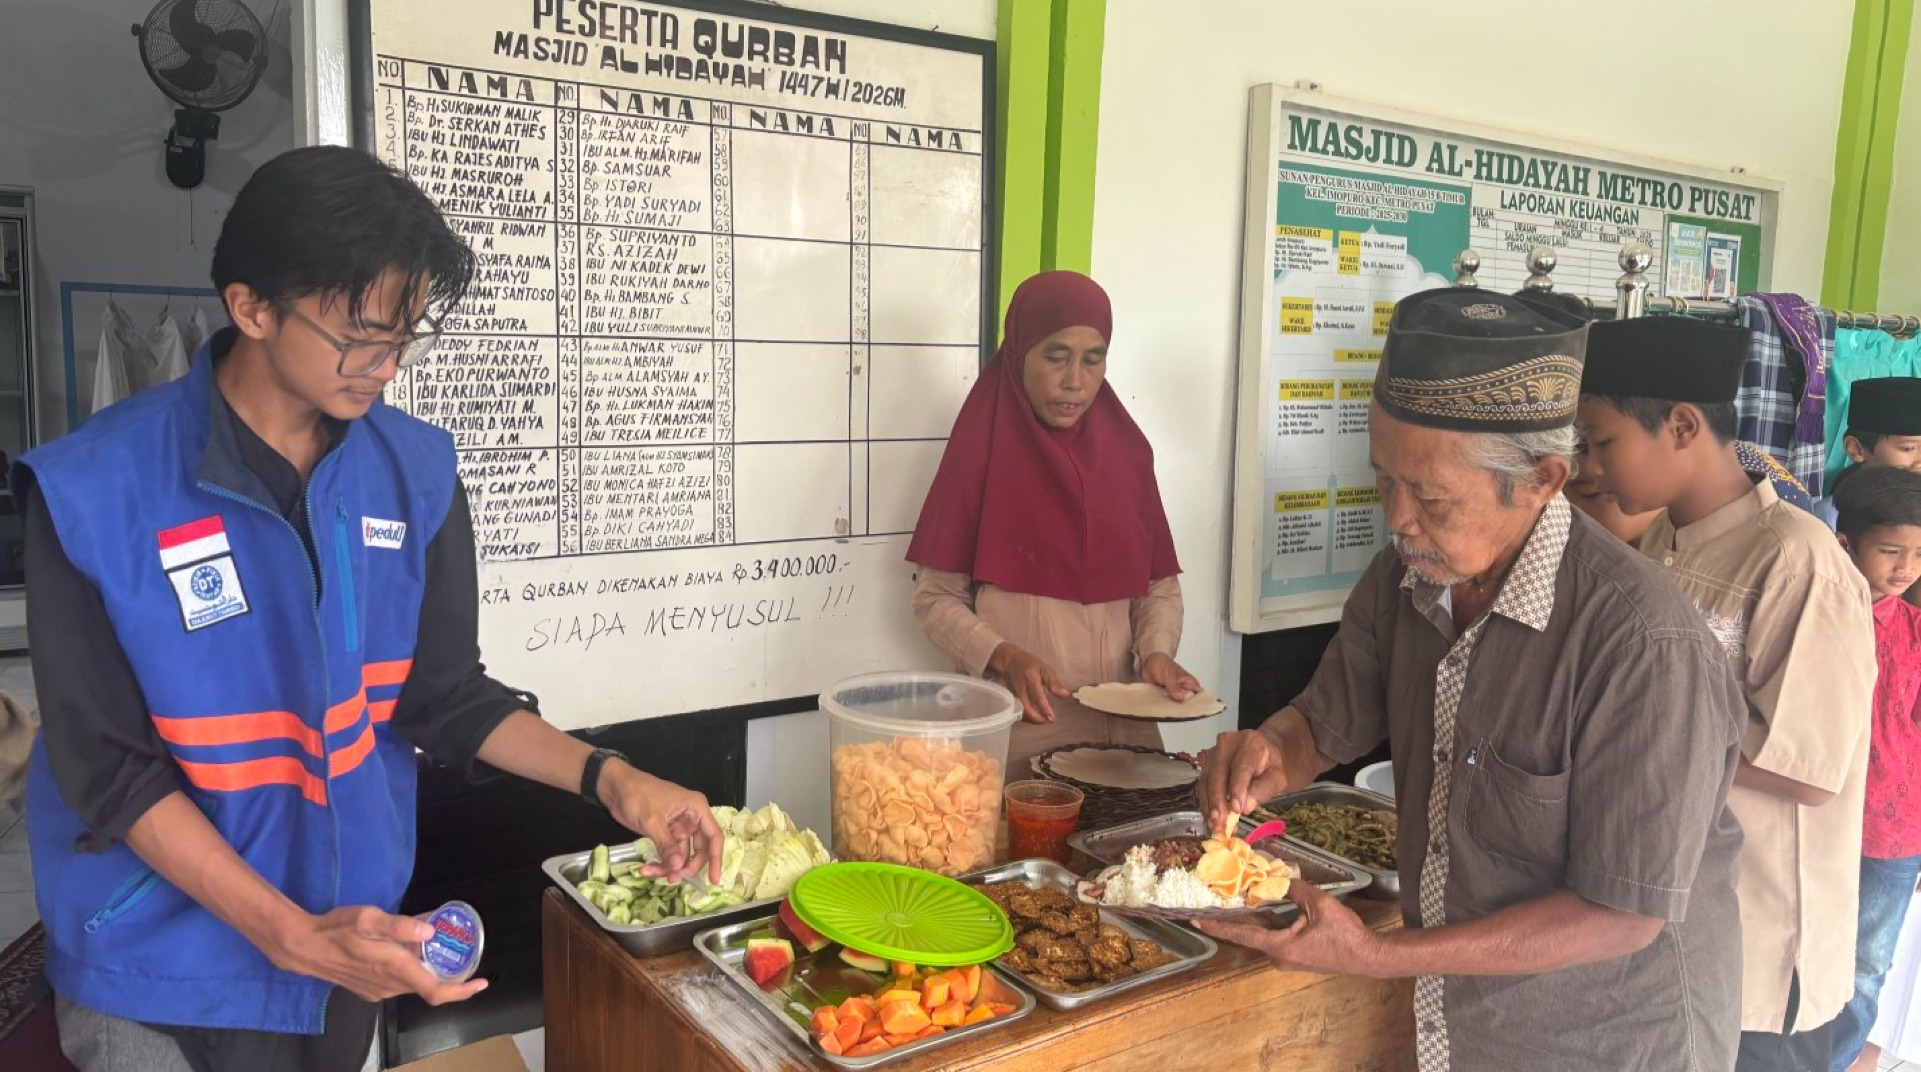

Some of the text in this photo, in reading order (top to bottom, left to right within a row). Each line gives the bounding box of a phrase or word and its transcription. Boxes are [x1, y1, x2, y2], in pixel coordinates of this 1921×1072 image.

[533, 0, 846, 74] PESERTA QURBAN
[494, 30, 588, 66] MASJID
[428, 66, 535, 101] NAMA
[601, 91, 694, 120] NAMA
[505, 106, 542, 122] MALIK
[429, 116, 547, 140] Dr. SERKAN ATHES
[750, 108, 835, 137] NAMA
[408, 129, 520, 152] IBU LINDAWATI
[640, 134, 672, 150] ARIF
[886, 125, 963, 150] NAMA
[560, 143, 574, 156] 31
[583, 145, 602, 157] IBU
[431, 149, 540, 171] KA RAJES ADITYA
[560, 159, 575, 173] 32
[1287, 114, 1755, 220] MASJID AL-HIDAYAH METRO PUSAT
[603, 161, 672, 178] SAMSUAR
[451, 169, 524, 186] MASRUROH
[560, 176, 574, 189] 33
[450, 183, 536, 203] ASMARA LELA
[1354, 180, 1382, 192] MASJID
[605, 194, 702, 213] YADI SURYADI
[1385, 198, 1412, 209] METRO
[1500, 190, 1640, 225] LAPORAN KEUANGAN
[489, 203, 547, 219] YULIANTI
[559, 205, 575, 219] 35
[624, 210, 682, 227] SUMAJI
[500, 224, 546, 238] RIDWAN
[559, 225, 575, 238] 36
[609, 228, 697, 247] SUPRIYANTO
[1280, 227, 1321, 237] PENASEHAT
[561, 240, 576, 254] 37
[613, 245, 679, 261] AZIZAH
[515, 256, 551, 269] RAINA
[560, 255, 576, 270] 38
[586, 258, 706, 275] IBU NI KADEK DEWI
[474, 269, 530, 284] RAHAYU
[560, 273, 575, 286] 39
[586, 273, 606, 285] IBU
[610, 273, 668, 289] RUKIYAH
[504, 287, 555, 302] SANTOSO
[561, 288, 575, 301] 40
[618, 290, 675, 305] BAMBANG
[559, 305, 574, 318] 41
[585, 305, 664, 319] IBU BIBIT
[473, 318, 528, 331] SAPUTRA
[561, 320, 578, 333] 42
[584, 321, 604, 333] IBU
[607, 322, 637, 334] YULI
[478, 339, 539, 352] FEDRIAN
[621, 341, 665, 353] ANWAR
[670, 342, 705, 354] YUSUF
[492, 354, 542, 370] ARRAFI
[561, 354, 578, 366] 44
[623, 355, 674, 367] AMBIYAH
[436, 366, 549, 382] EKO PURWANTO
[562, 370, 577, 382] 45
[626, 370, 689, 383] ALAMSYAH
[441, 382, 556, 399] KARLIDA SUMARDI
[561, 385, 578, 399] 46
[584, 386, 697, 398] IBU HUSNA SYAIMA
[416, 402, 438, 415] IBU
[457, 401, 517, 415] RUMIYATI
[562, 401, 578, 413] 47
[623, 400, 672, 410] LUKMAN
[500, 416, 544, 429] YAHYA
[561, 417, 578, 429] 48
[605, 414, 636, 426] AGUS
[561, 432, 578, 444] 49
[584, 428, 707, 442] IBU TRESIA MEILICE
[479, 450, 532, 464] IBROHIM
[561, 451, 577, 462] 50
[584, 450, 599, 461] IBU
[603, 450, 636, 462] LIANA
[526, 462, 537, 474] R
[563, 465, 577, 477] 51
[582, 462, 685, 475] IBU AMRIZAL KOTO
[488, 479, 556, 495] CAHYONO
[562, 479, 578, 493] 52
[584, 475, 711, 491] IBU MONICA AZIZI
[486, 496, 558, 512] KURNIAWAN
[562, 493, 578, 507] 53
[584, 490, 711, 505] IBU MENTARI AMRIANA
[504, 510, 557, 524] GUNADI
[561, 509, 578, 522] 54
[605, 504, 693, 520] IMAM PRAYOGA
[562, 525, 577, 537] 55
[604, 522, 632, 534] DIKI
[586, 534, 692, 550] IBU BERLIANA SANDRA
[522, 580, 588, 602] QURBAN
[597, 574, 679, 595] DIKENAKAN
[684, 569, 723, 587] BIAYA
[526, 597, 801, 652] SIAPA MENYUSUL
